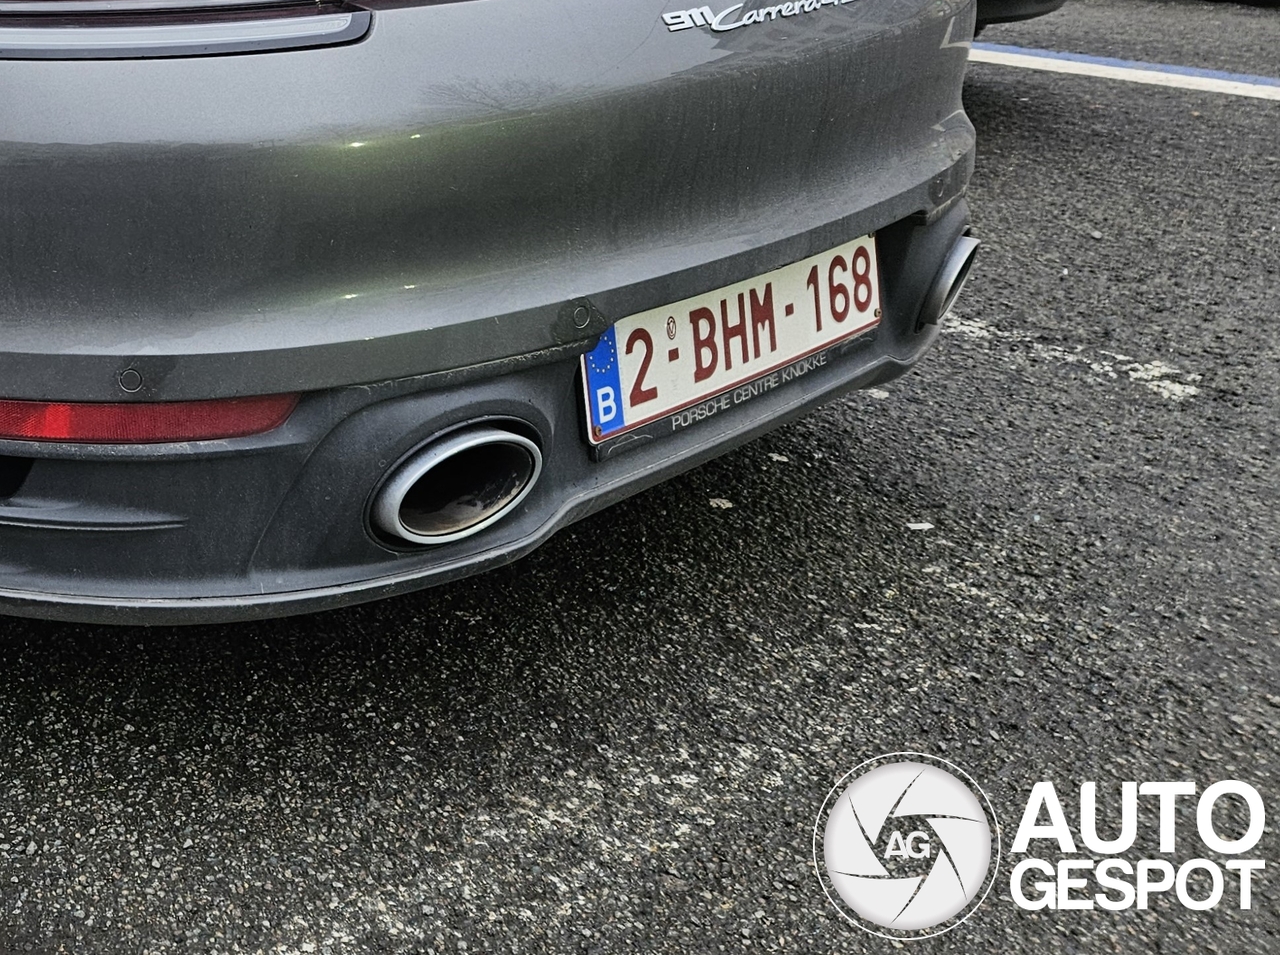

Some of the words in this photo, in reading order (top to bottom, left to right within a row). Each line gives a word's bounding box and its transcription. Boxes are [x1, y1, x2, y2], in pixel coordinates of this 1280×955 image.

[596, 386, 617, 424] B
[625, 246, 873, 408] 2-BHM-168
[672, 395, 731, 430] PORSCHE
[733, 374, 779, 404] CENTRE
[782, 352, 827, 383] KNOKKE
